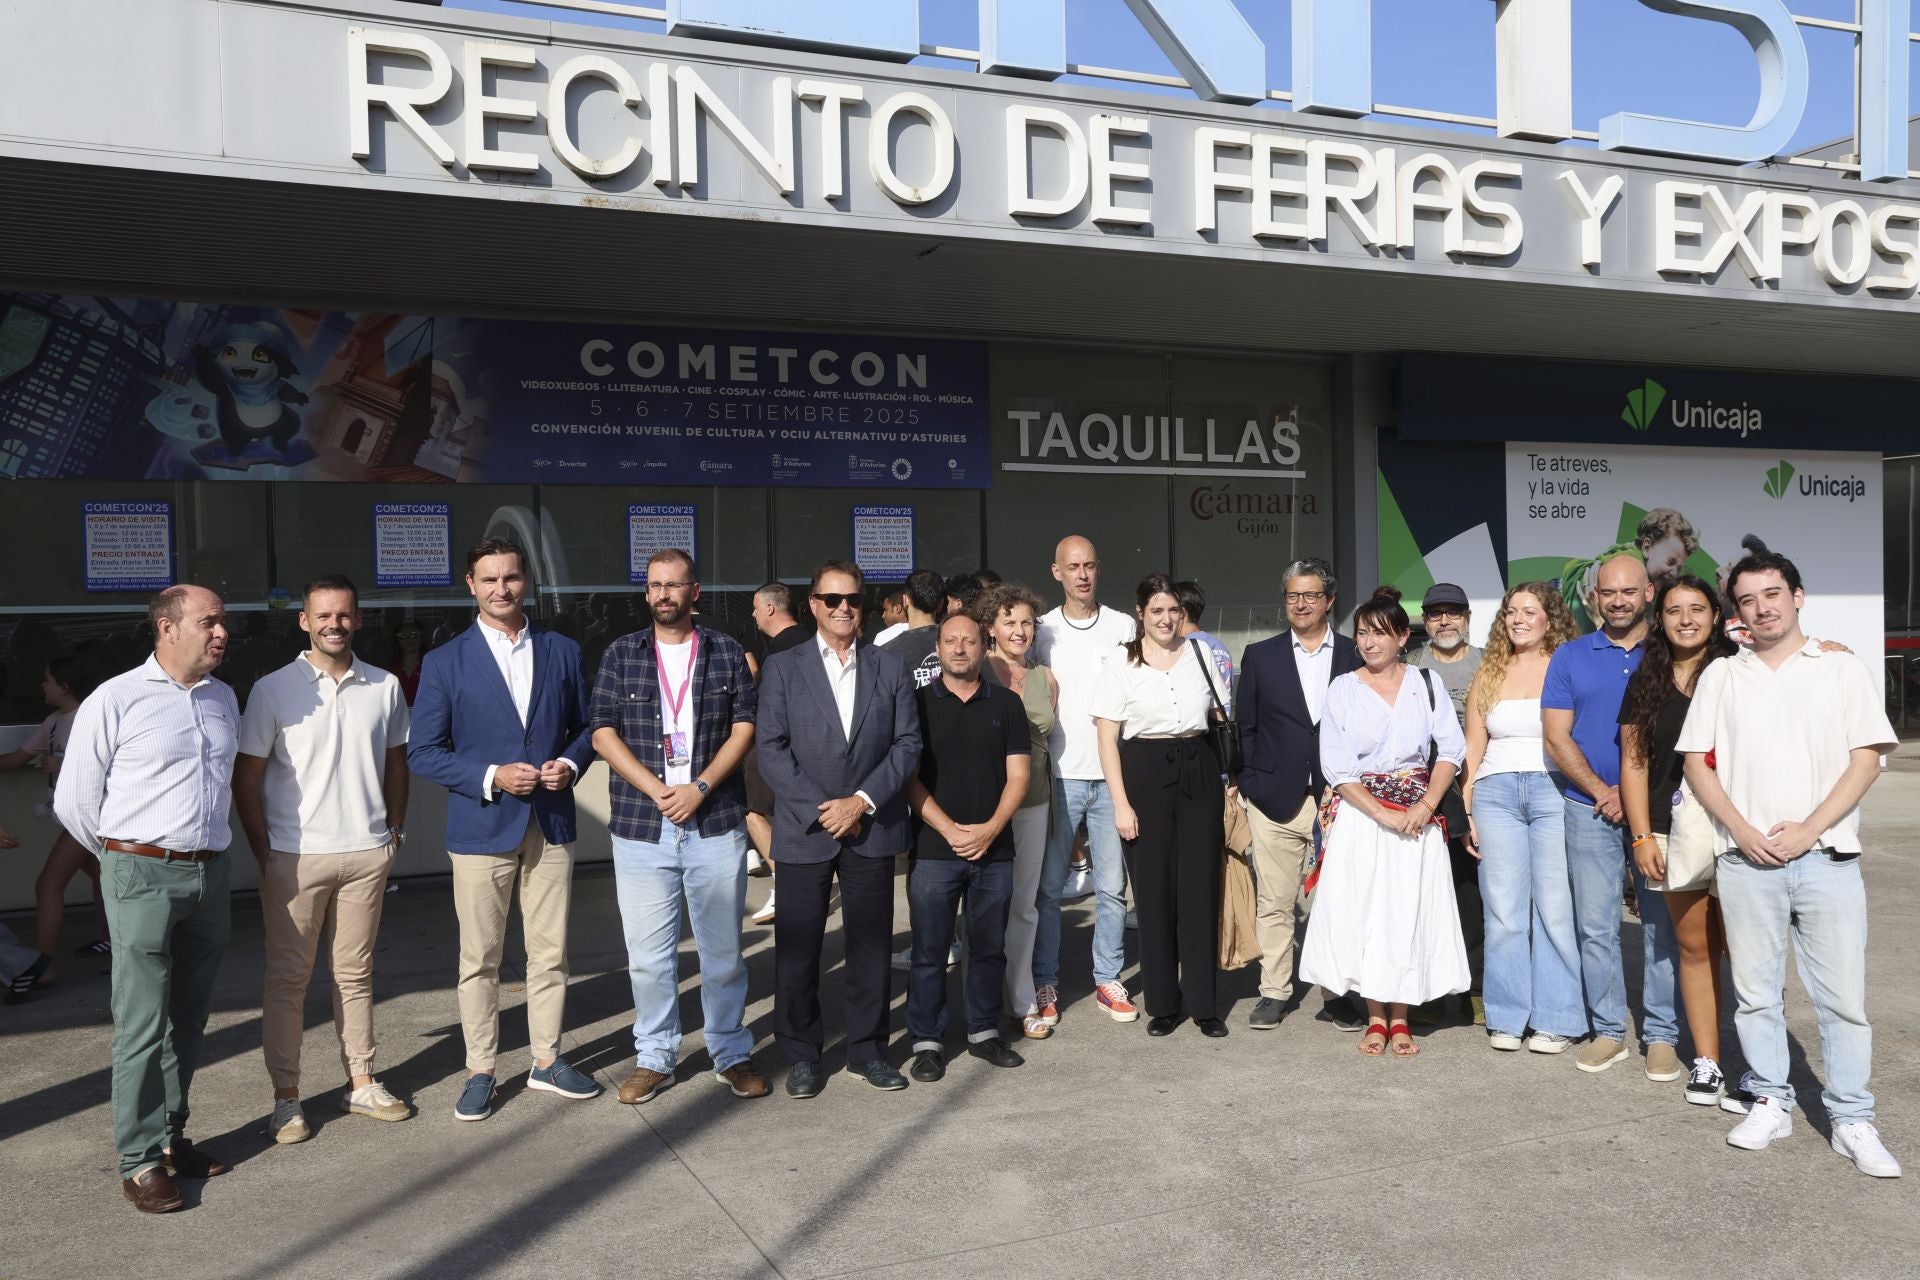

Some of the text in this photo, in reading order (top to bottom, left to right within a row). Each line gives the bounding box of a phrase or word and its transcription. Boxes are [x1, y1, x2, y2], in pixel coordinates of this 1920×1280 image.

[348, 26, 954, 206] RECINTO
[1006, 105, 1151, 226] DE
[1196, 126, 1523, 258] FERIAS
[1557, 170, 1625, 267] Y
[1656, 180, 1920, 292] EXPOS
[580, 338, 928, 388] COMETCON
[520, 379, 600, 392] VIDEOXUEGOS
[607, 383, 680, 394] LLITERATURA
[687, 386, 713, 395] CINE
[719, 387, 767, 397] COSPLAY
[774, 387, 808, 399] CÓMIC
[843, 390, 907, 402] ILUSTRACIÓN
[913, 394, 932, 403] ROL
[938, 392, 975, 404] MÚSICA
[590, 399, 920, 425] 5 6 7 SETIEMBRE 2025
[1671, 398, 1763, 439] Unicaja
[531, 422, 967, 444] CONVENCIÓN XUVENIL DE CULTURA Y OCIU ALTERNATIVU D'ASTURIES
[1008, 410, 1301, 466] TAQUILLAS
[1527, 454, 1612, 475] Te atreves,
[1528, 477, 1590, 500] y la vida
[1799, 474, 1865, 502] Unicaja
[85, 503, 168, 512] COMETCON'25
[854, 507, 911, 515] COMETCON'25
[1529, 502, 1586, 519] se abre
[1237, 518, 1279, 538] Gijón
